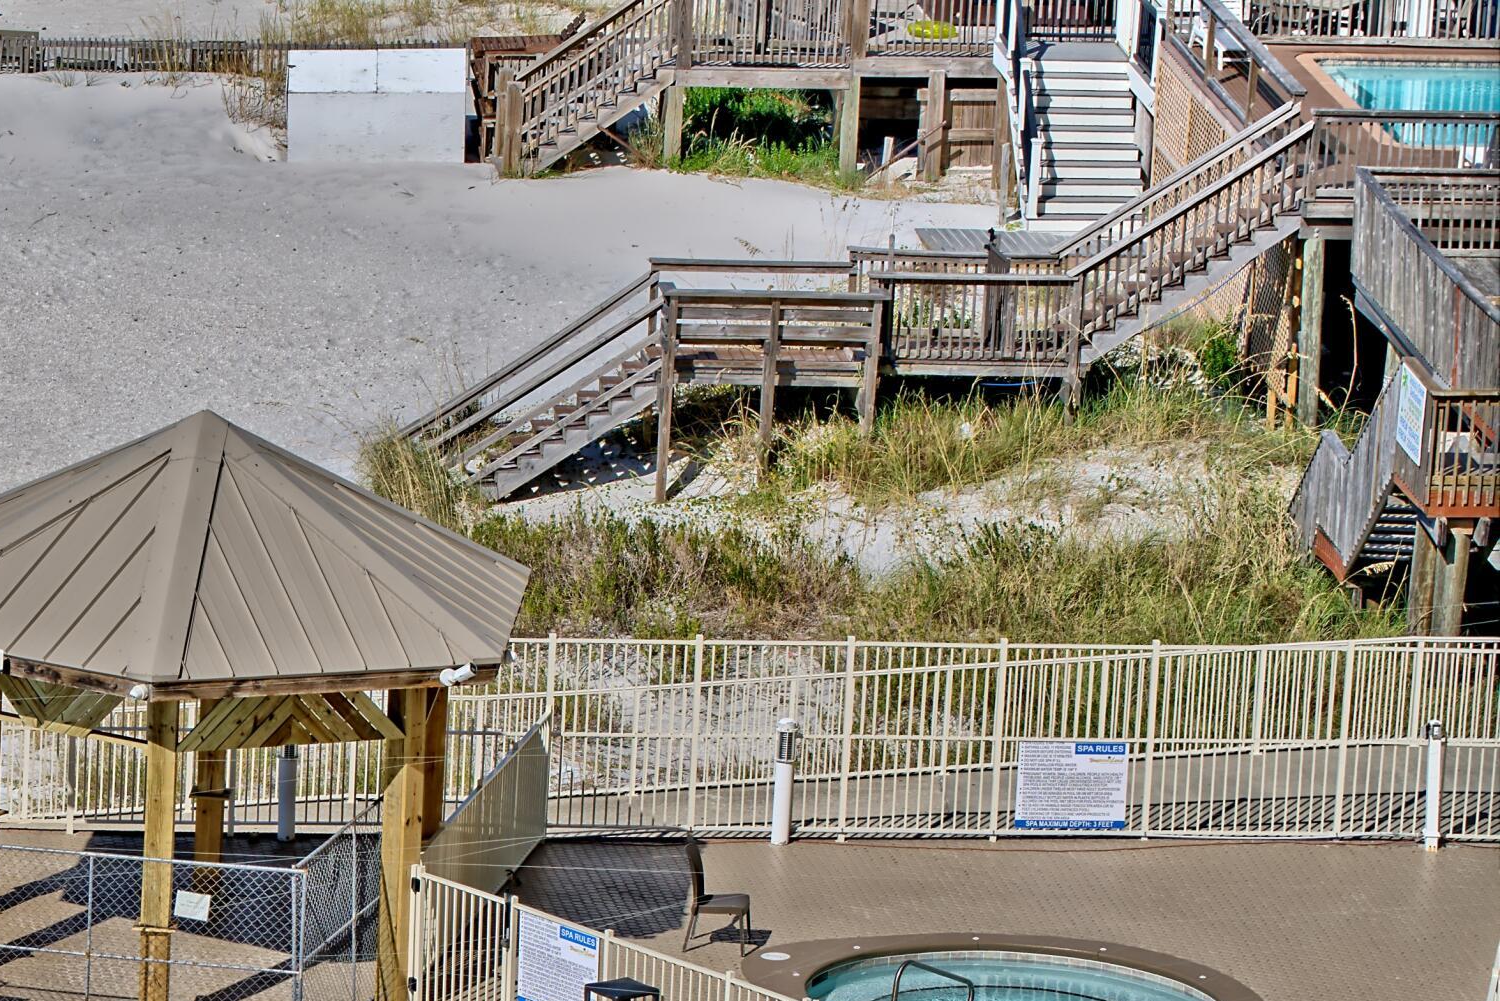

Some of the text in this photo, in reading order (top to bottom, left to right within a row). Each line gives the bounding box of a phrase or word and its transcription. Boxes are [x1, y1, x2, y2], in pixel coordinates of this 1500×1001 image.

[1077, 745, 1096, 753] SPA
[1097, 745, 1124, 753] RULES
[560, 928, 596, 946] SPA RULES
